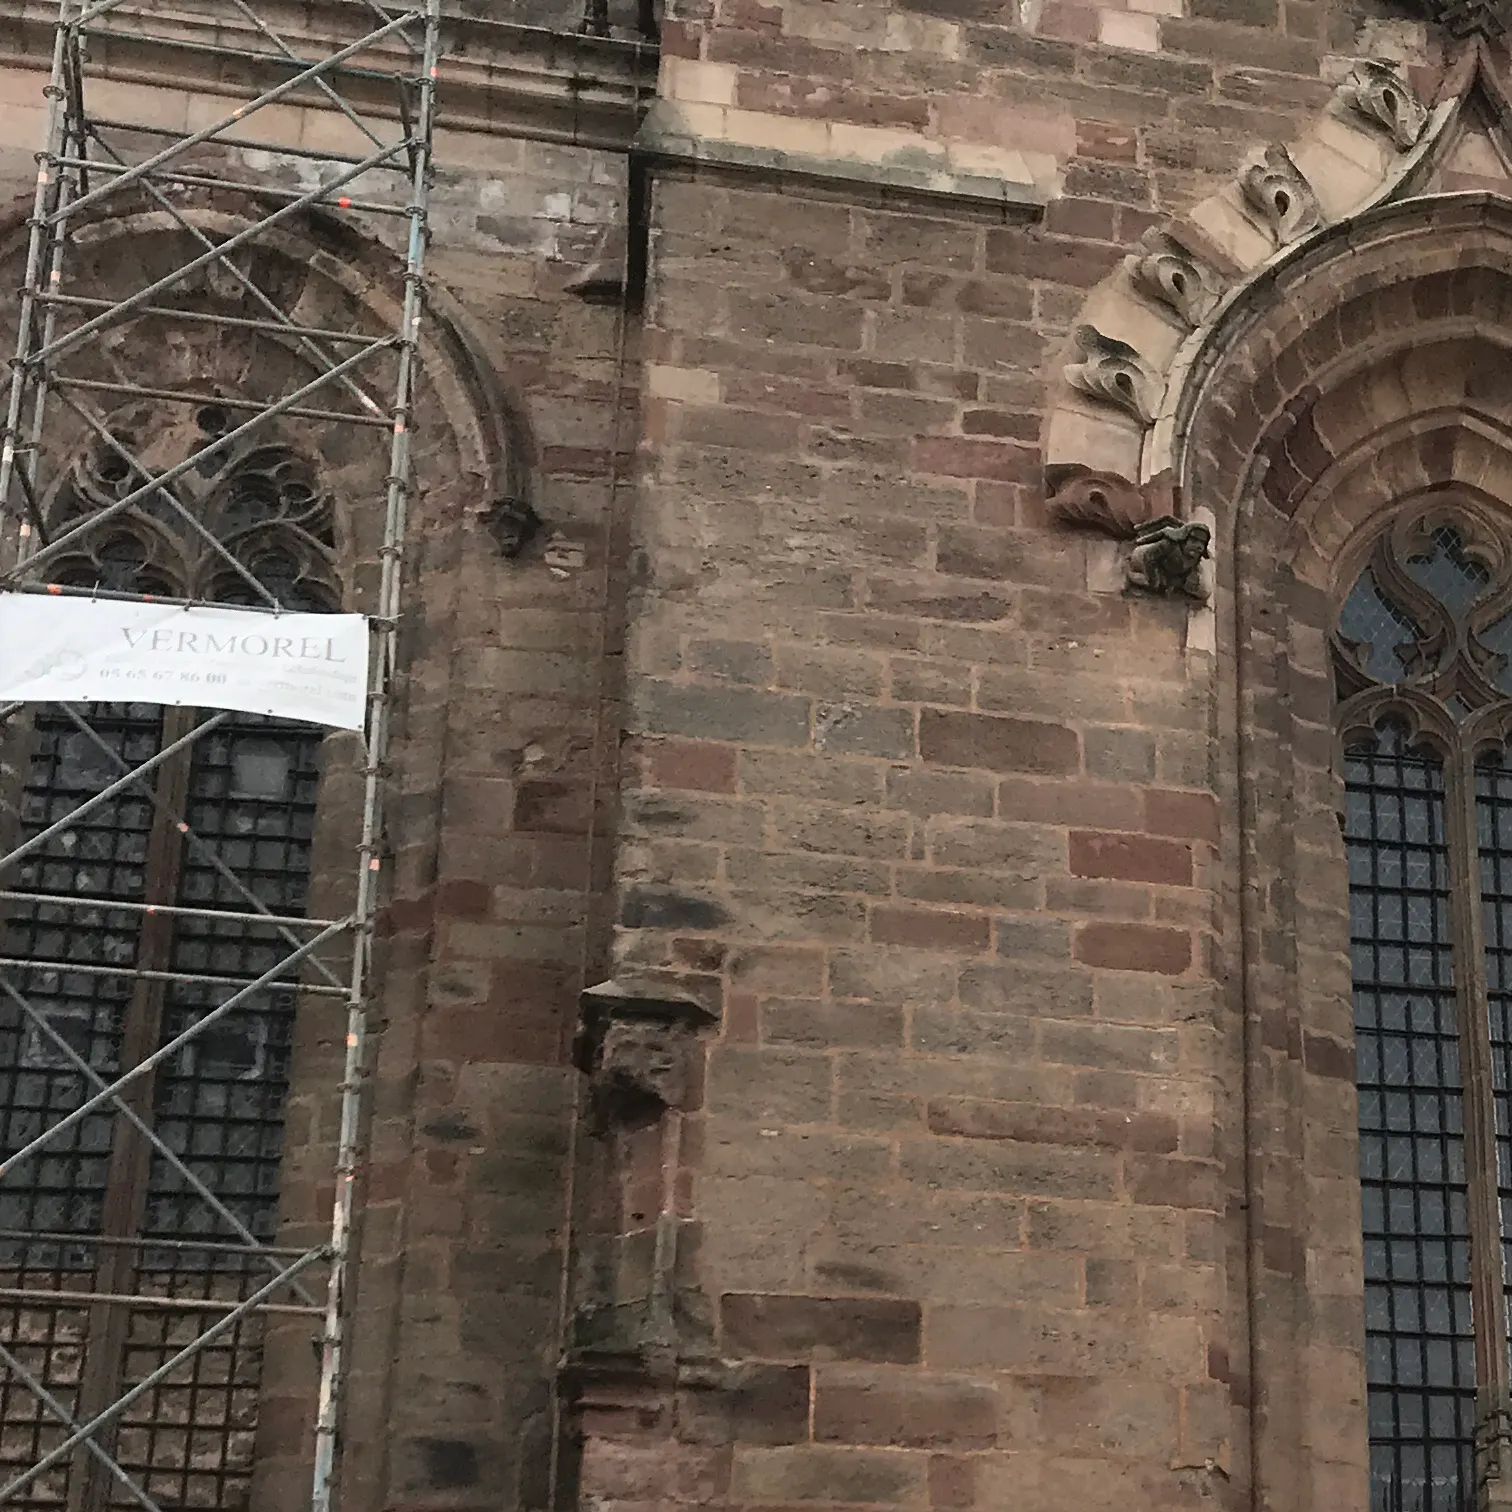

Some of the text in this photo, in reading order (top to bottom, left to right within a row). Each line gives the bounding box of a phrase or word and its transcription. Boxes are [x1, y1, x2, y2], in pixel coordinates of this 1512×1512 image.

[121, 627, 345, 662] VERMOREL
[100, 668, 120, 679] 05
[152, 670, 173, 680] 67
